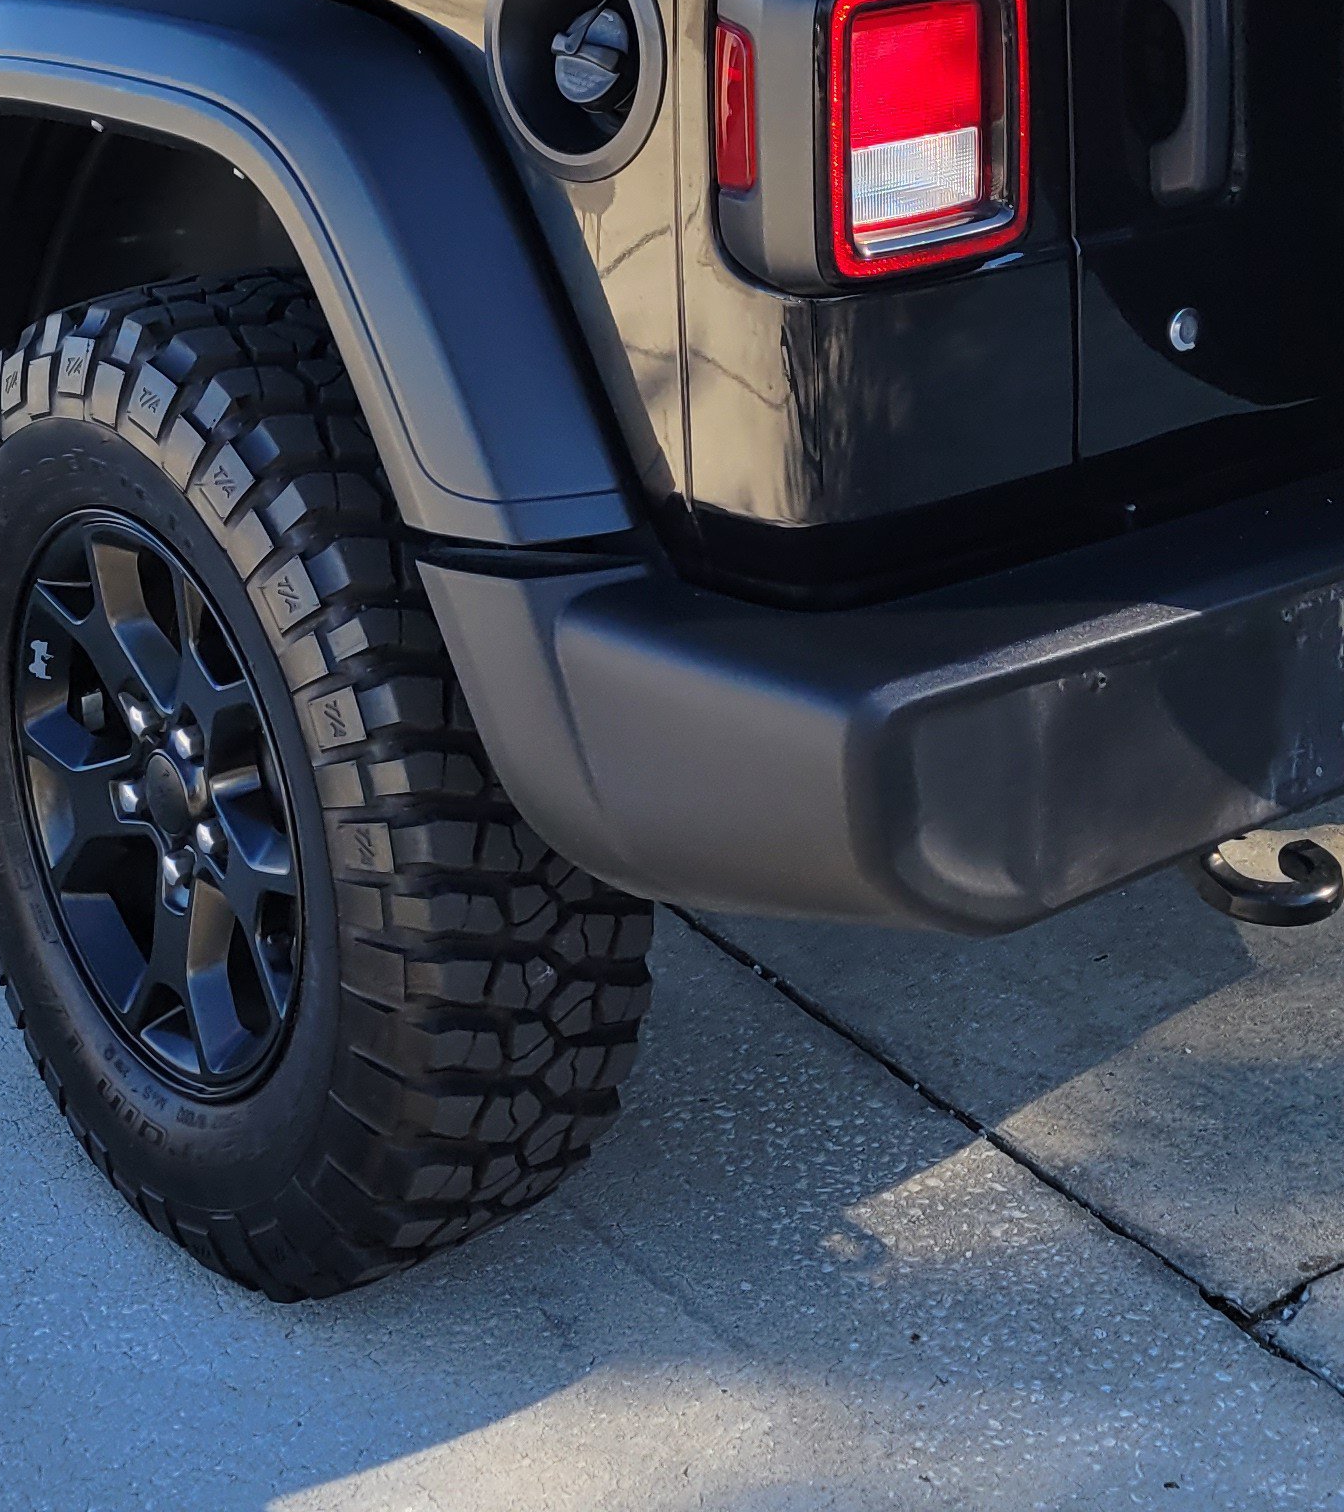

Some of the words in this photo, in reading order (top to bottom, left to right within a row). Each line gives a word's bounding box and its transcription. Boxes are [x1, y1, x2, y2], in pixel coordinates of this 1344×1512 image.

[139, 386, 162, 415] T/A
[212, 464, 236, 499] T/A
[276, 574, 301, 615] T/A
[323, 698, 348, 739] T/A
